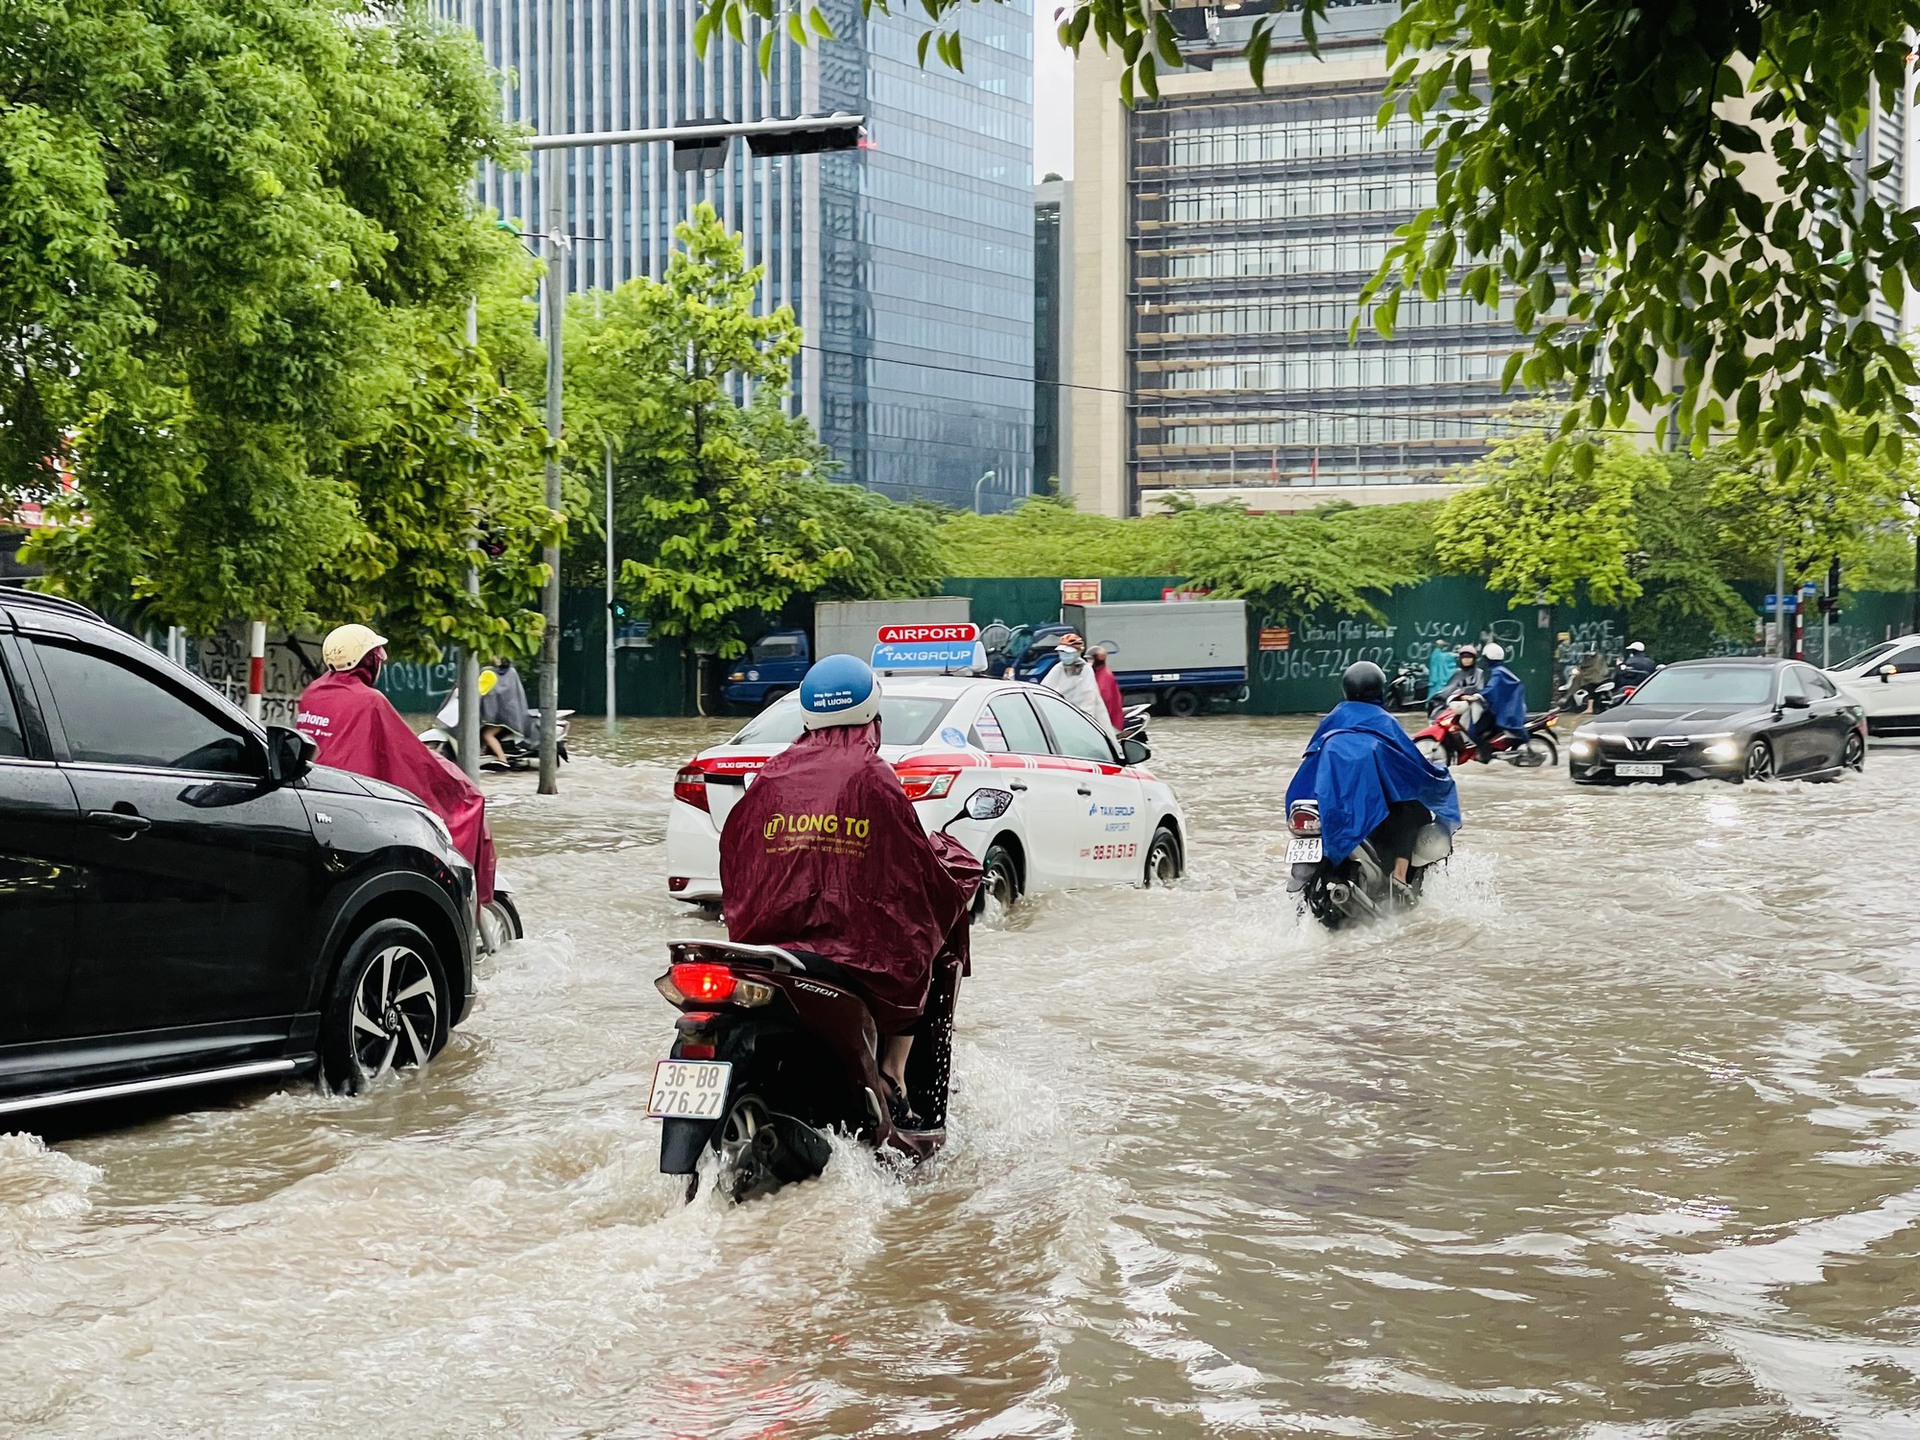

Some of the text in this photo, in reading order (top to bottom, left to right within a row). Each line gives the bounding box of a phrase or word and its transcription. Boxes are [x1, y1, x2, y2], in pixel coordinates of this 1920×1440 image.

[885, 627, 969, 641] AIRPORT
[1414, 620, 1470, 637] VSCN
[735, 761, 765, 769] GROUP
[788, 814, 838, 834] LONG
[1105, 822, 1130, 832] AIRPORT
[1093, 843, 1137, 860] 38.51.51.51
[665, 1065, 720, 1089] 36-B8
[653, 1090, 721, 1115] 276.27
